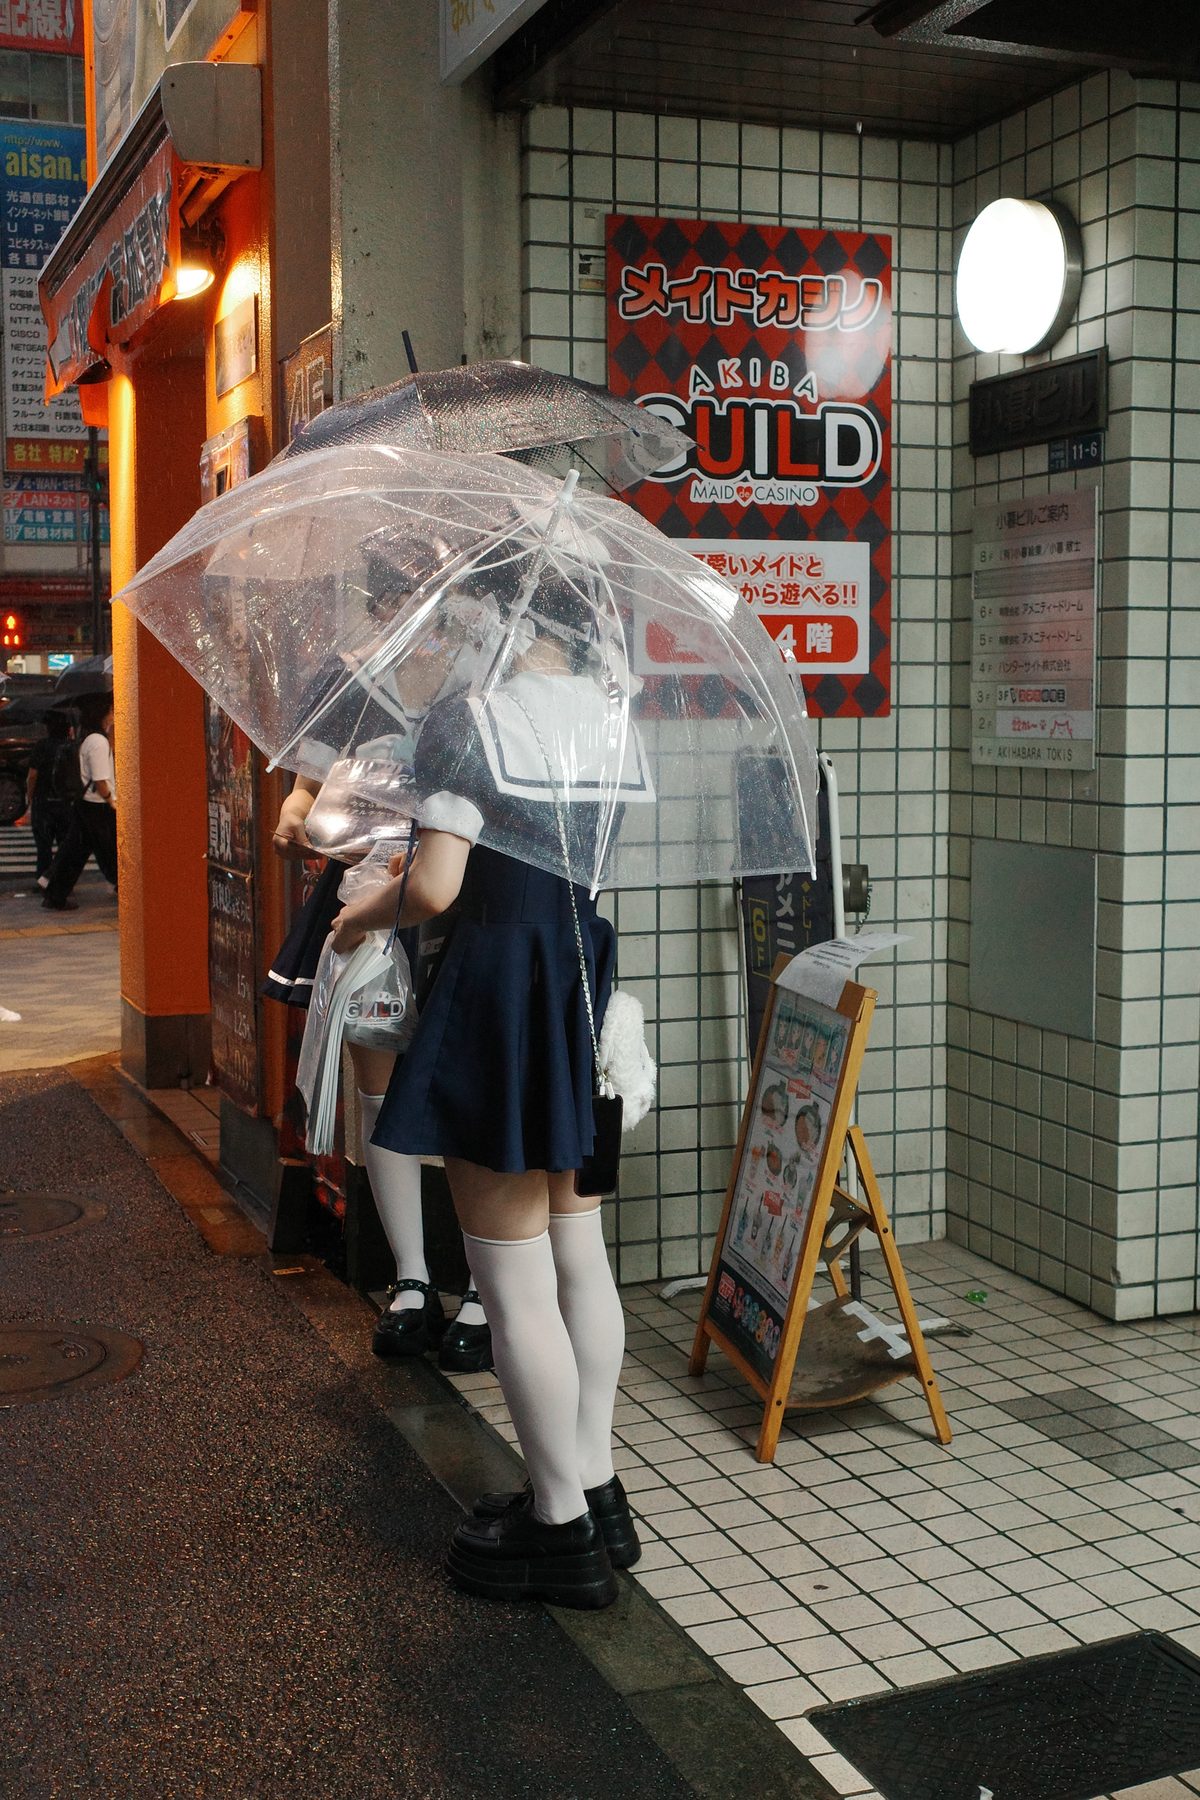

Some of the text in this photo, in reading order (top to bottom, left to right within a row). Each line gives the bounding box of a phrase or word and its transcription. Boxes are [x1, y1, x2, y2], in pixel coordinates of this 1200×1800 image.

[620, 264, 881, 331] メイドカジノ
[689, 358, 819, 402] AKIBA
[1072, 441, 1098, 461] 11-6
[693, 485, 735, 499] MAID
[754, 486, 817, 502] CASINO
